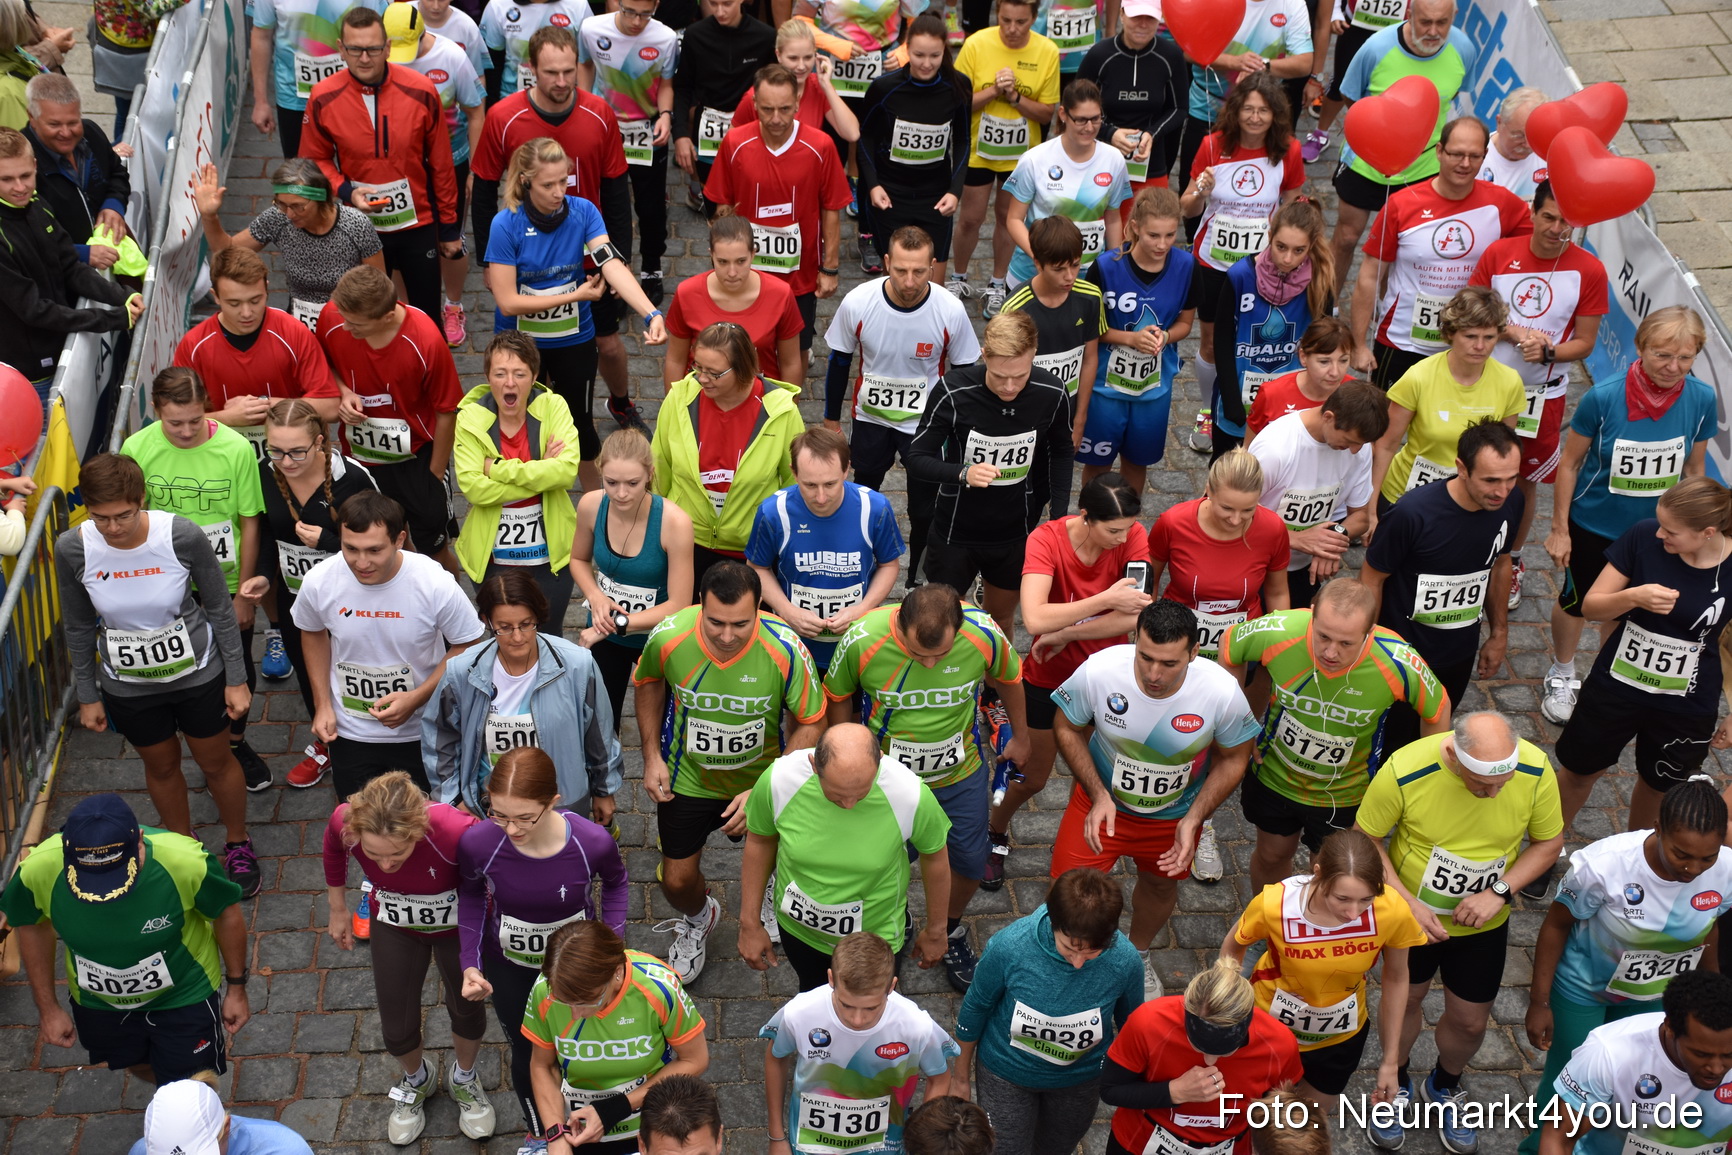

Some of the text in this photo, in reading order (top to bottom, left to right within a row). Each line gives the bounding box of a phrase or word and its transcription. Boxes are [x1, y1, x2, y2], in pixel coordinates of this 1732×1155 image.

[1361, 0, 1401, 17] 5152
[1053, 17, 1091, 36] 5117
[834, 61, 877, 80] 5072
[1118, 90, 1149, 100] R&D
[896, 124, 914, 132] PARTL
[982, 116, 998, 126] PARTL
[899, 132, 944, 150] 5339
[984, 125, 1026, 145] 5310
[1215, 219, 1230, 227] PARTL
[753, 237, 797, 255] 5100
[1217, 229, 1264, 250] 5017
[761, 257, 786, 266] Daniel
[1237, 342, 1297, 357] FIBALO
[1114, 356, 1158, 379] 5160
[865, 377, 884, 385] PARTL
[867, 388, 920, 409] 5312
[352, 425, 402, 452] 5141
[970, 436, 1026, 447] PARTL Neumarkt
[972, 446, 1028, 467] 5148
[1642, 444, 1675, 452] Neumarkt
[1619, 453, 1677, 475] 5111
[1627, 480, 1666, 490] Theresia
[1284, 493, 1308, 501] PARTL
[1284, 498, 1335, 523] 5021
[508, 547, 546, 558] Gabriele
[794, 551, 861, 566] HUBER
[113, 567, 165, 578] KLEBL
[810, 564, 859, 572] TECHNOLOGY
[1420, 577, 1479, 587] PARTL Neumarkt
[793, 589, 815, 599] PARTL
[1423, 584, 1481, 610] 5149
[355, 609, 405, 619] KLEBL
[1202, 618, 1235, 626] Neumarkt
[1435, 611, 1462, 622] Katrin
[108, 629, 172, 643] PARTL Neumarkt
[1626, 626, 1688, 652] PARTL Neumarkt
[117, 635, 185, 667] 5109
[1625, 638, 1688, 676] 5151
[137, 667, 175, 678] Nadine
[337, 663, 399, 677] PARTL Neumarkt
[1636, 670, 1661, 687] Jana
[346, 675, 408, 699] 5056
[876, 680, 975, 710] BOCK
[675, 684, 772, 715] BOCK
[1275, 683, 1376, 727] BOCK
[487, 719, 512, 729] PARTL
[1104, 712, 1127, 725] PARTL
[1175, 717, 1200, 729] Hervis
[690, 721, 752, 735] PARTL Neumarkt
[1281, 714, 1343, 747] PARTL Neumarkt
[696, 731, 758, 753] 5163
[892, 741, 954, 754] PARTL Neumarkt
[1283, 727, 1346, 764] 5179
[706, 755, 747, 764] Sleiman
[900, 746, 959, 771] 5173
[1292, 756, 1316, 772] Jens
[1116, 759, 1181, 776] PARTL Neumarkt
[1120, 772, 1183, 796] 5164
[1137, 797, 1162, 808] Azad
[1433, 851, 1495, 876] PARTL Neumarkt
[404, 897, 444, 906] Neumarkt
[787, 887, 849, 916] PARTL Neumarkt
[385, 902, 453, 925] 5187
[788, 900, 856, 935] 5320
[142, 914, 171, 931] AOK
[503, 921, 529, 931] PARTL
[1284, 941, 1380, 960] MAX BÖGL
[1624, 952, 1648, 961] PARTL
[78, 959, 149, 979] PARTL Neumarkt
[1625, 955, 1690, 982] 5326
[87, 970, 163, 994] 5023
[1277, 994, 1345, 1015] PARTL Neumarkt
[1016, 1008, 1088, 1029] PARTL Neumarkt
[1279, 1007, 1350, 1030] 5174
[1021, 1023, 1094, 1049] 5028
[555, 1035, 654, 1061] BOCK
[880, 1045, 906, 1056] Hervis
[1034, 1039, 1075, 1061] Claudia
[563, 1087, 590, 1099] PARTL
[802, 1097, 875, 1111] PARTL Neumarkt
[809, 1106, 882, 1134] 5130
[815, 1133, 867, 1147] Jonathan
